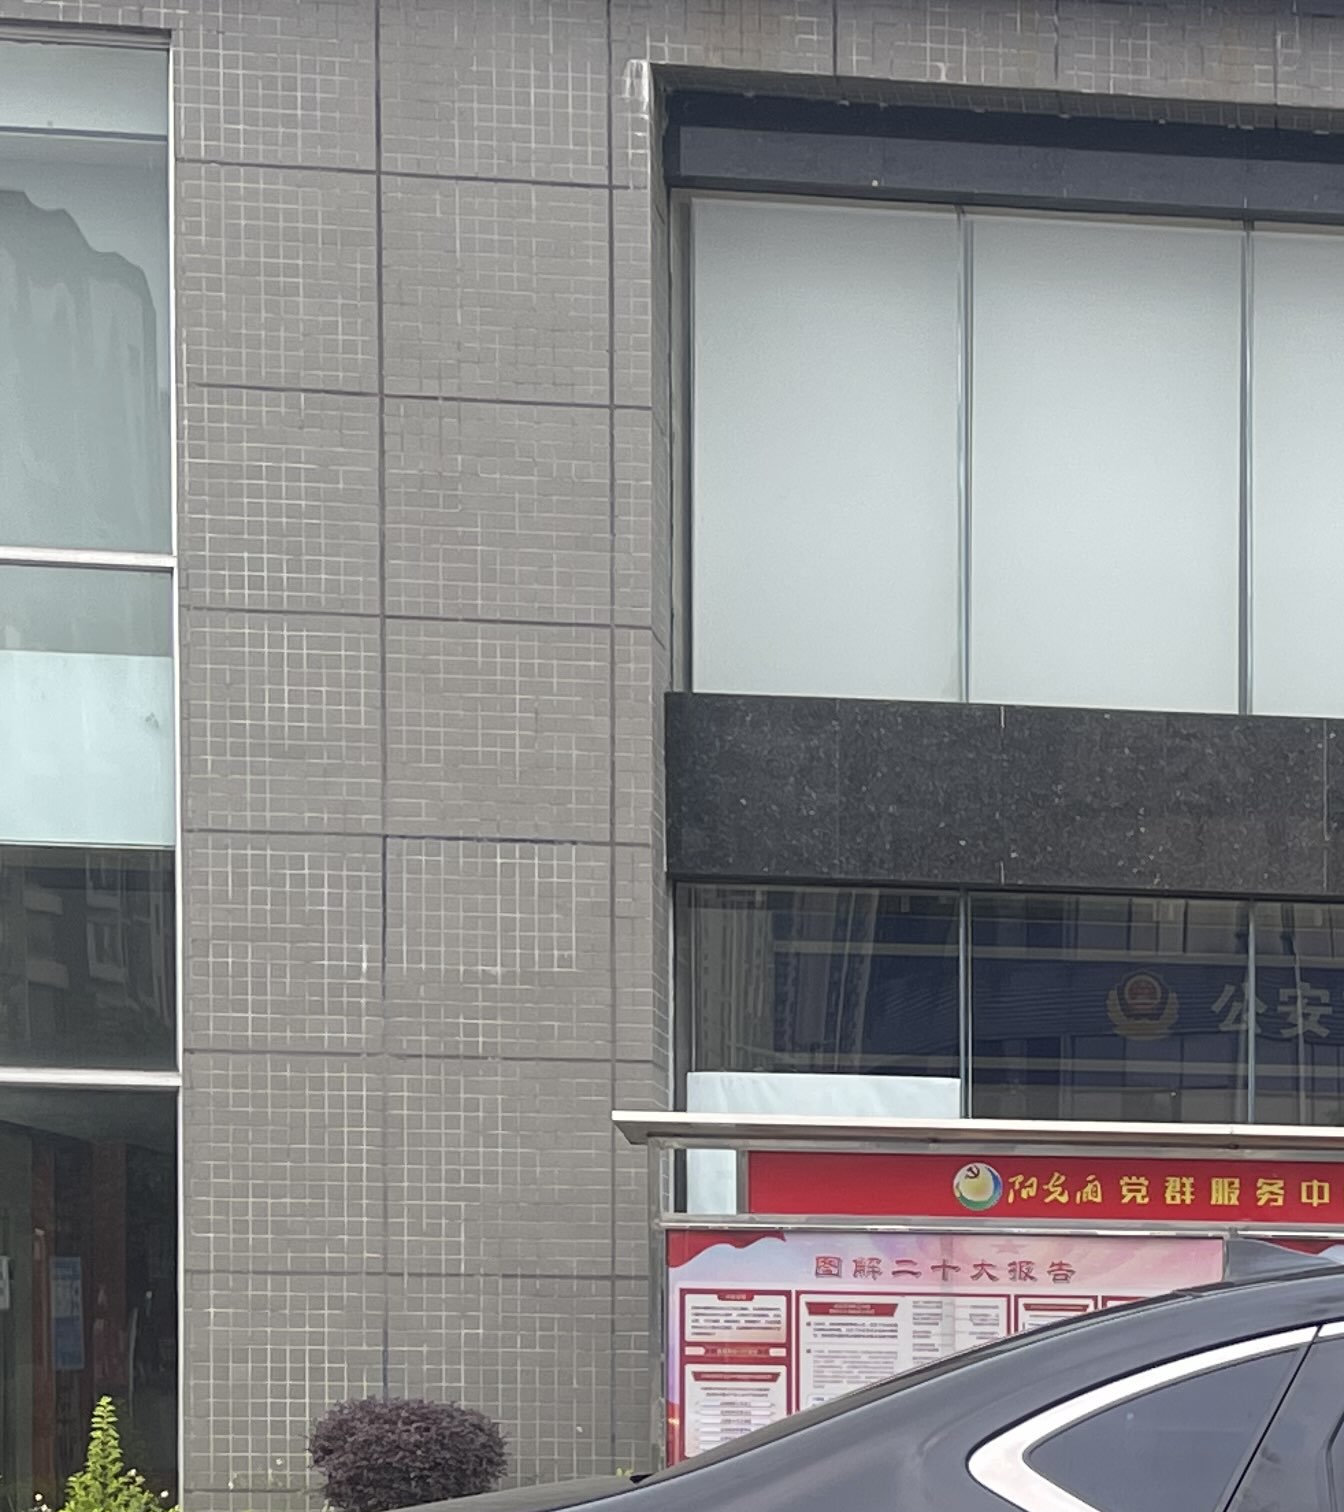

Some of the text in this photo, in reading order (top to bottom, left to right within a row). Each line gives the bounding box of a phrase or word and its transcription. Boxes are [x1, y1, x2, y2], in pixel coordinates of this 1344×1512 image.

[815, 1255, 1077, 1285] 图解二十大报告
